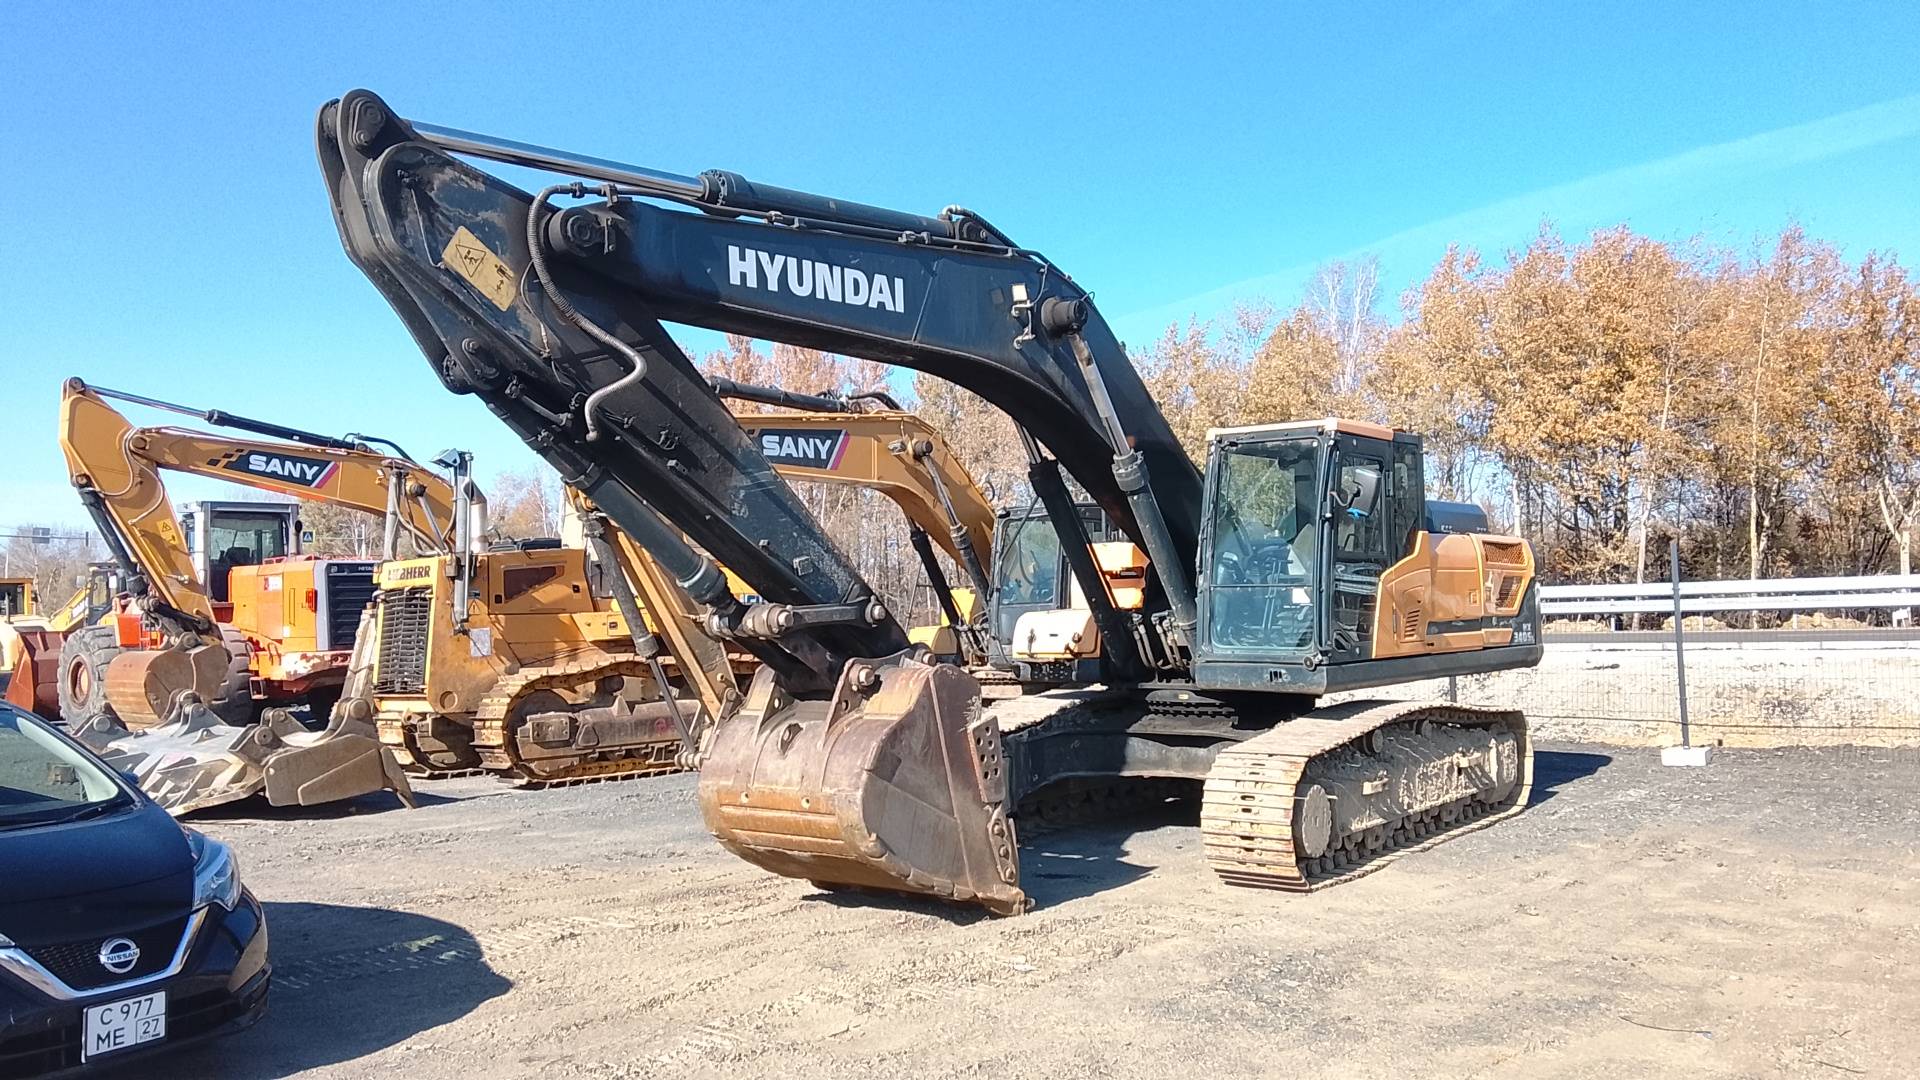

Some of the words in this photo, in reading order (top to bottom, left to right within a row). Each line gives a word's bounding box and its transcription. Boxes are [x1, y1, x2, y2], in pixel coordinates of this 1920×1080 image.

[728, 245, 904, 313] HYUNDAI
[762, 435, 832, 460] SANY
[248, 454, 319, 480] SANY
[106, 950, 138, 962] NISSAN
[100, 1008, 113, 1025] C
[120, 997, 154, 1021] 977
[96, 1027, 125, 1051] ME
[142, 1018, 159, 1035] 27
